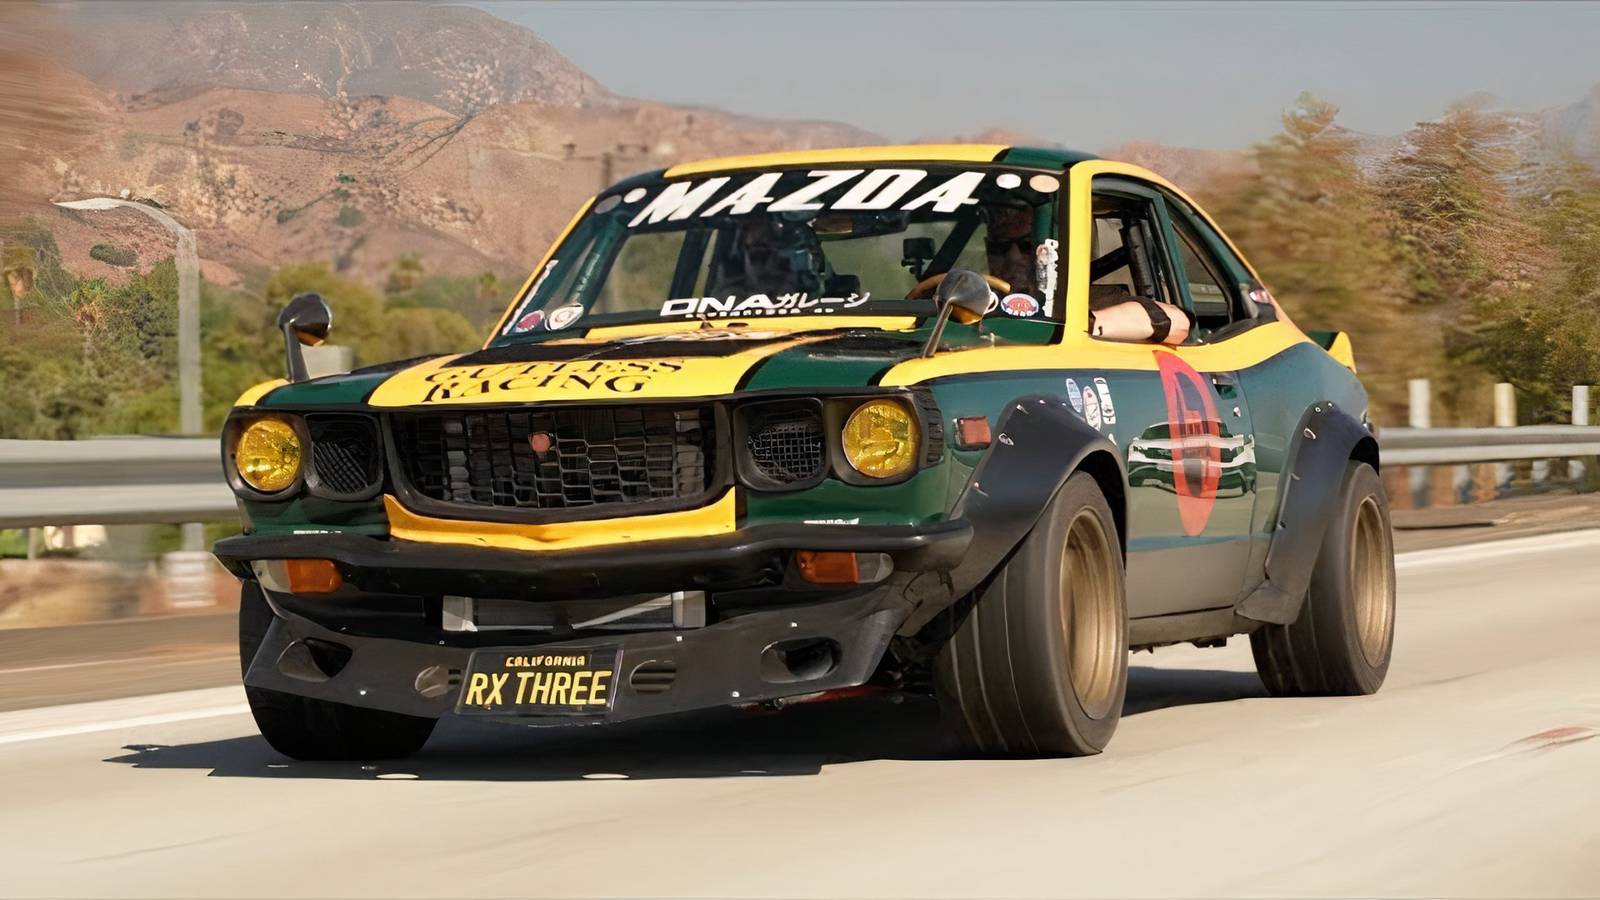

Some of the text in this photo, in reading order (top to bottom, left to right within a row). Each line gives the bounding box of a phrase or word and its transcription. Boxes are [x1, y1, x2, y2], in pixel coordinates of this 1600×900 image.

[627, 169, 985, 228] MAZDA
[421, 375, 651, 403] RACING
[505, 655, 586, 667] CALIFORNIA
[465, 670, 612, 705] RX THREE
